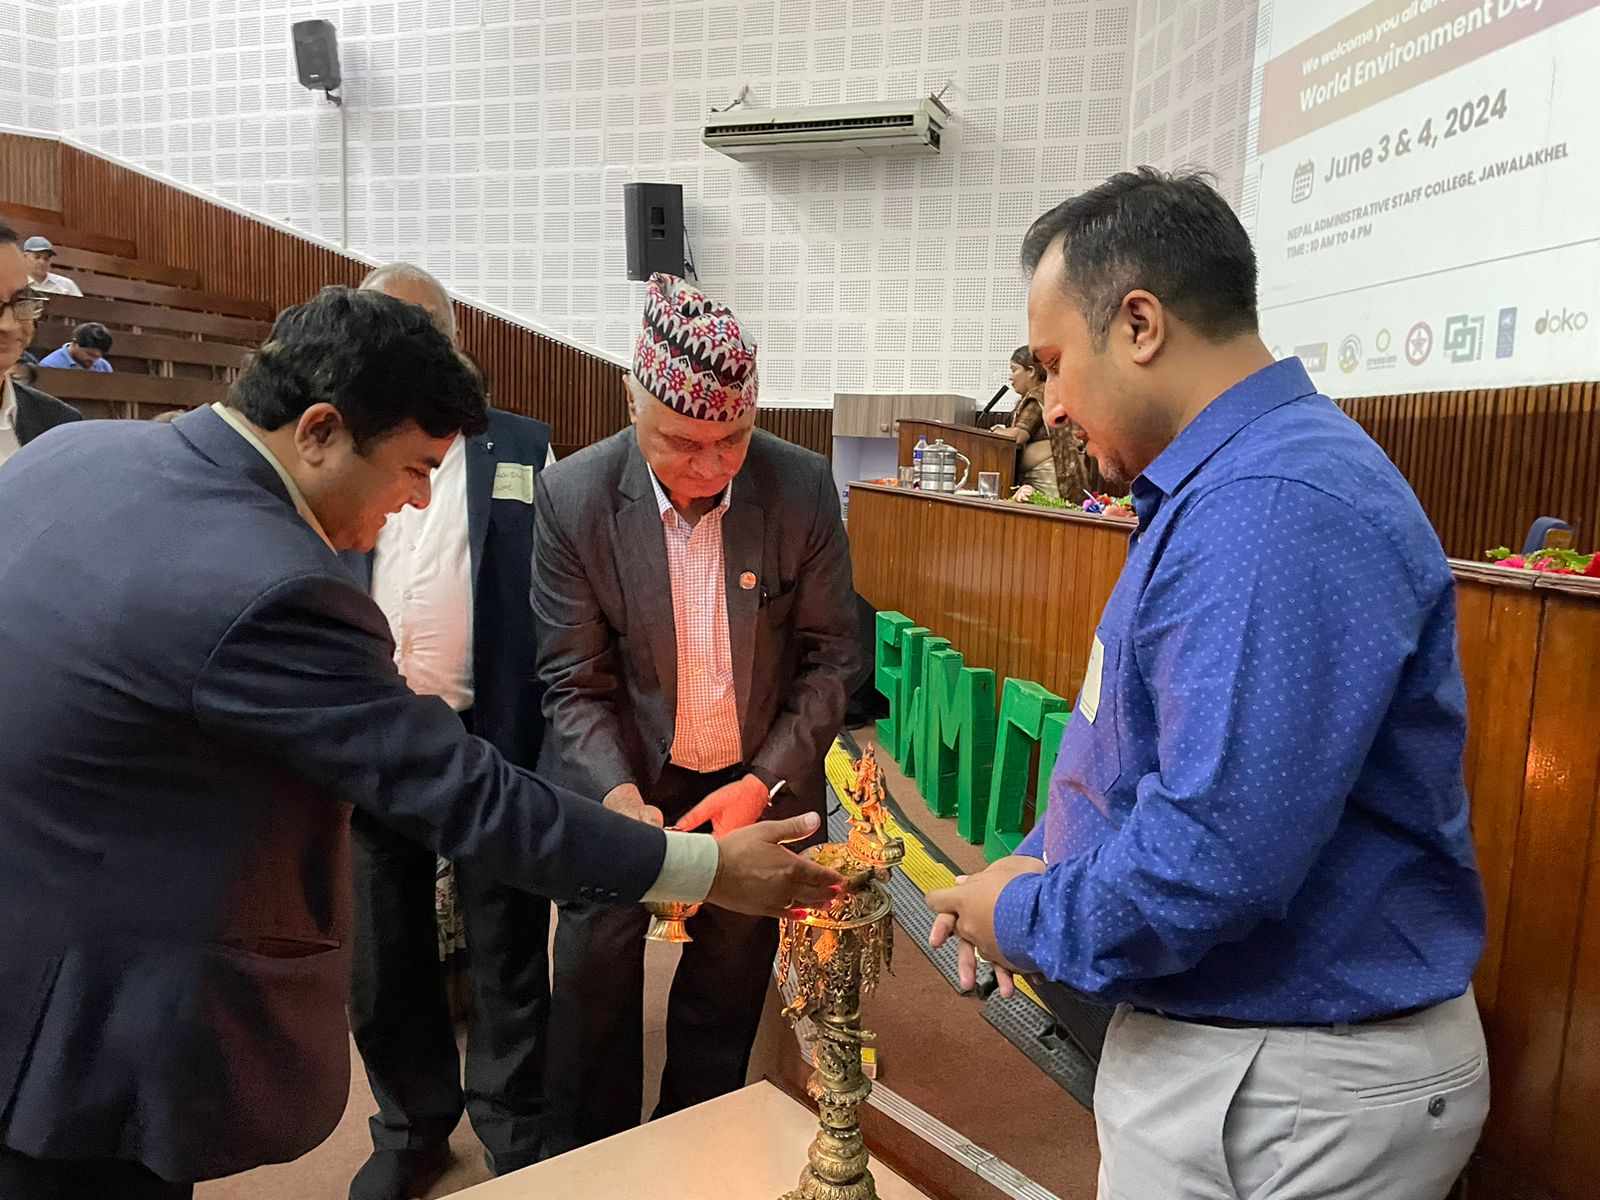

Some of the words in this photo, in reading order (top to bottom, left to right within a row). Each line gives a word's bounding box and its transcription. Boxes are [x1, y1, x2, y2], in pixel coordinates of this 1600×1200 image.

[1299, 65, 1351, 112] World
[1354, 1, 1492, 87] Environment
[1302, 51, 1319, 75] We
[1321, 28, 1375, 65] welcome
[1375, 14, 1400, 42] you
[1324, 147, 1373, 183] June
[1377, 134, 1390, 163] 3
[1395, 128, 1411, 156] &
[1417, 118, 1439, 149] 4,
[1443, 88, 1507, 139] 2024
[1287, 223, 1311, 242] NEPAL
[1314, 198, 1391, 232] ADMINISTRATIVE
[1391, 186, 1423, 209] STAFF
[1424, 170, 1477, 198] COLLEGE,
[1478, 142, 1568, 182] JAWALAKHEL
[1320, 234, 1335, 250] AM
[1335, 230, 1349, 245] TO
[1349, 228, 1356, 241] 4
[1357, 224, 1372, 240] PM
[1535, 307, 1588, 335] doko
